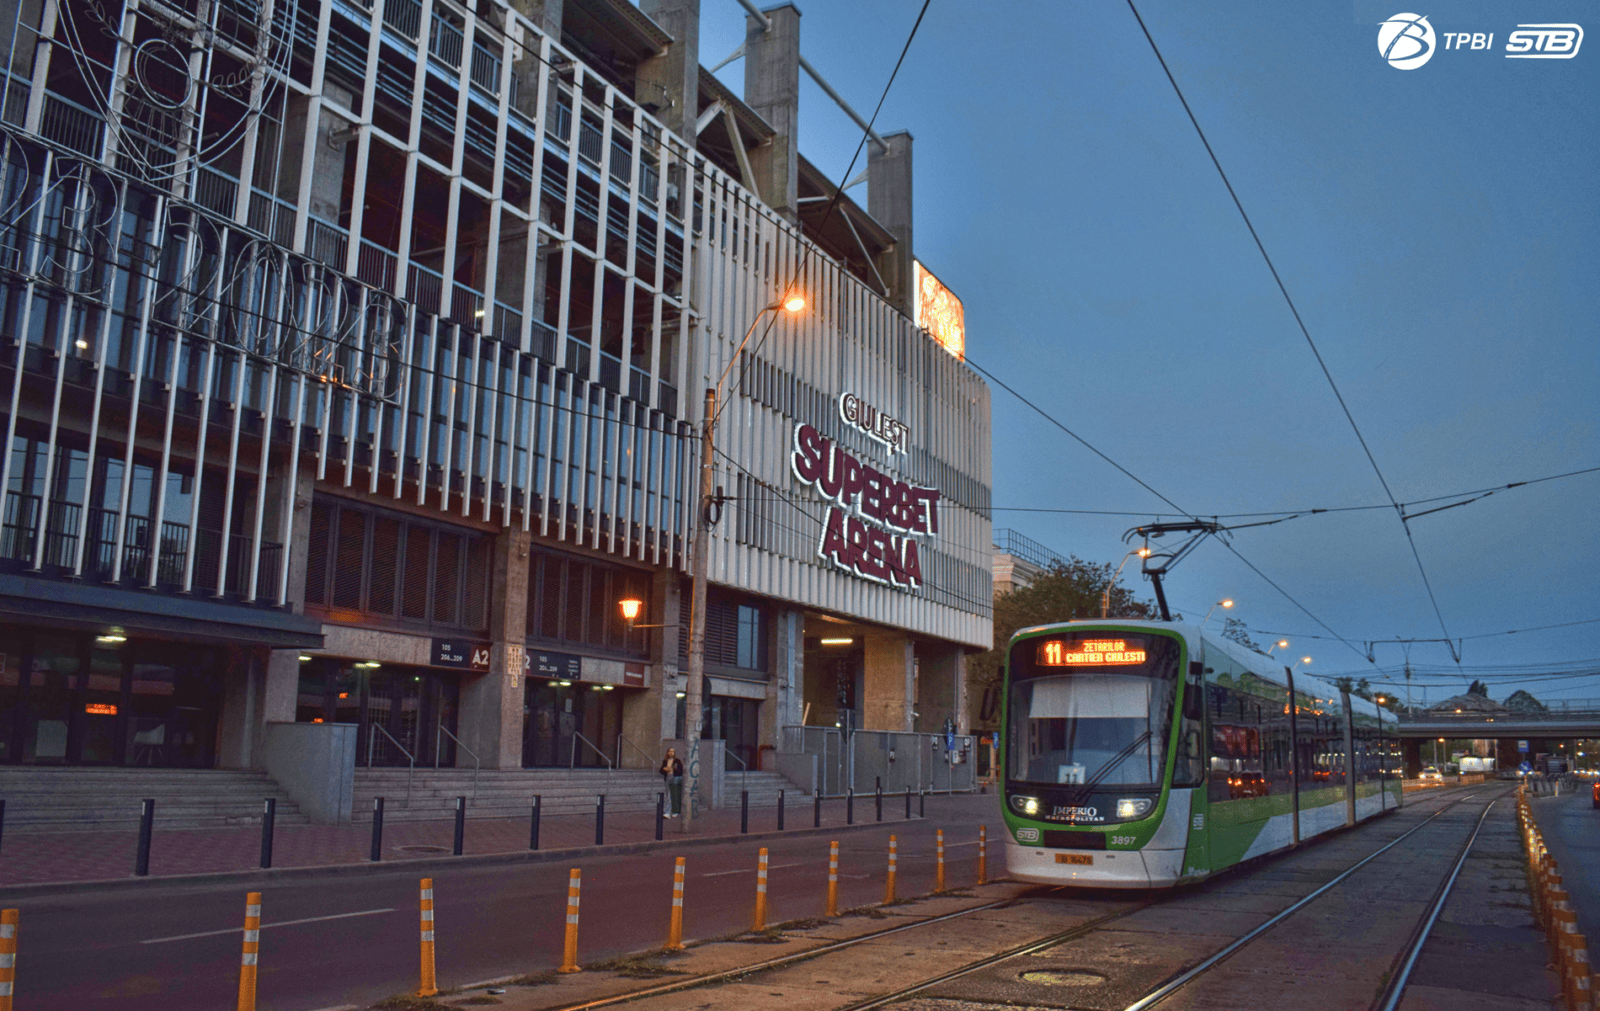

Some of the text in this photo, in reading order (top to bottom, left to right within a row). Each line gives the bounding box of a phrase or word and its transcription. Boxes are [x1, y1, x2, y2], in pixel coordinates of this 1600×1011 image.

[791, 422, 940, 536] SUPERBET
[818, 505, 922, 589] ARENA
[472, 649, 490, 665] A2
[1046, 643, 1061, 664] 11
[1066, 652, 1103, 663] CARTIER
[1065, 772, 1079, 784] 11
[1053, 805, 1098, 817] IMPERIO
[1016, 829, 1038, 840] STB
[1111, 835, 1137, 846] 3897
